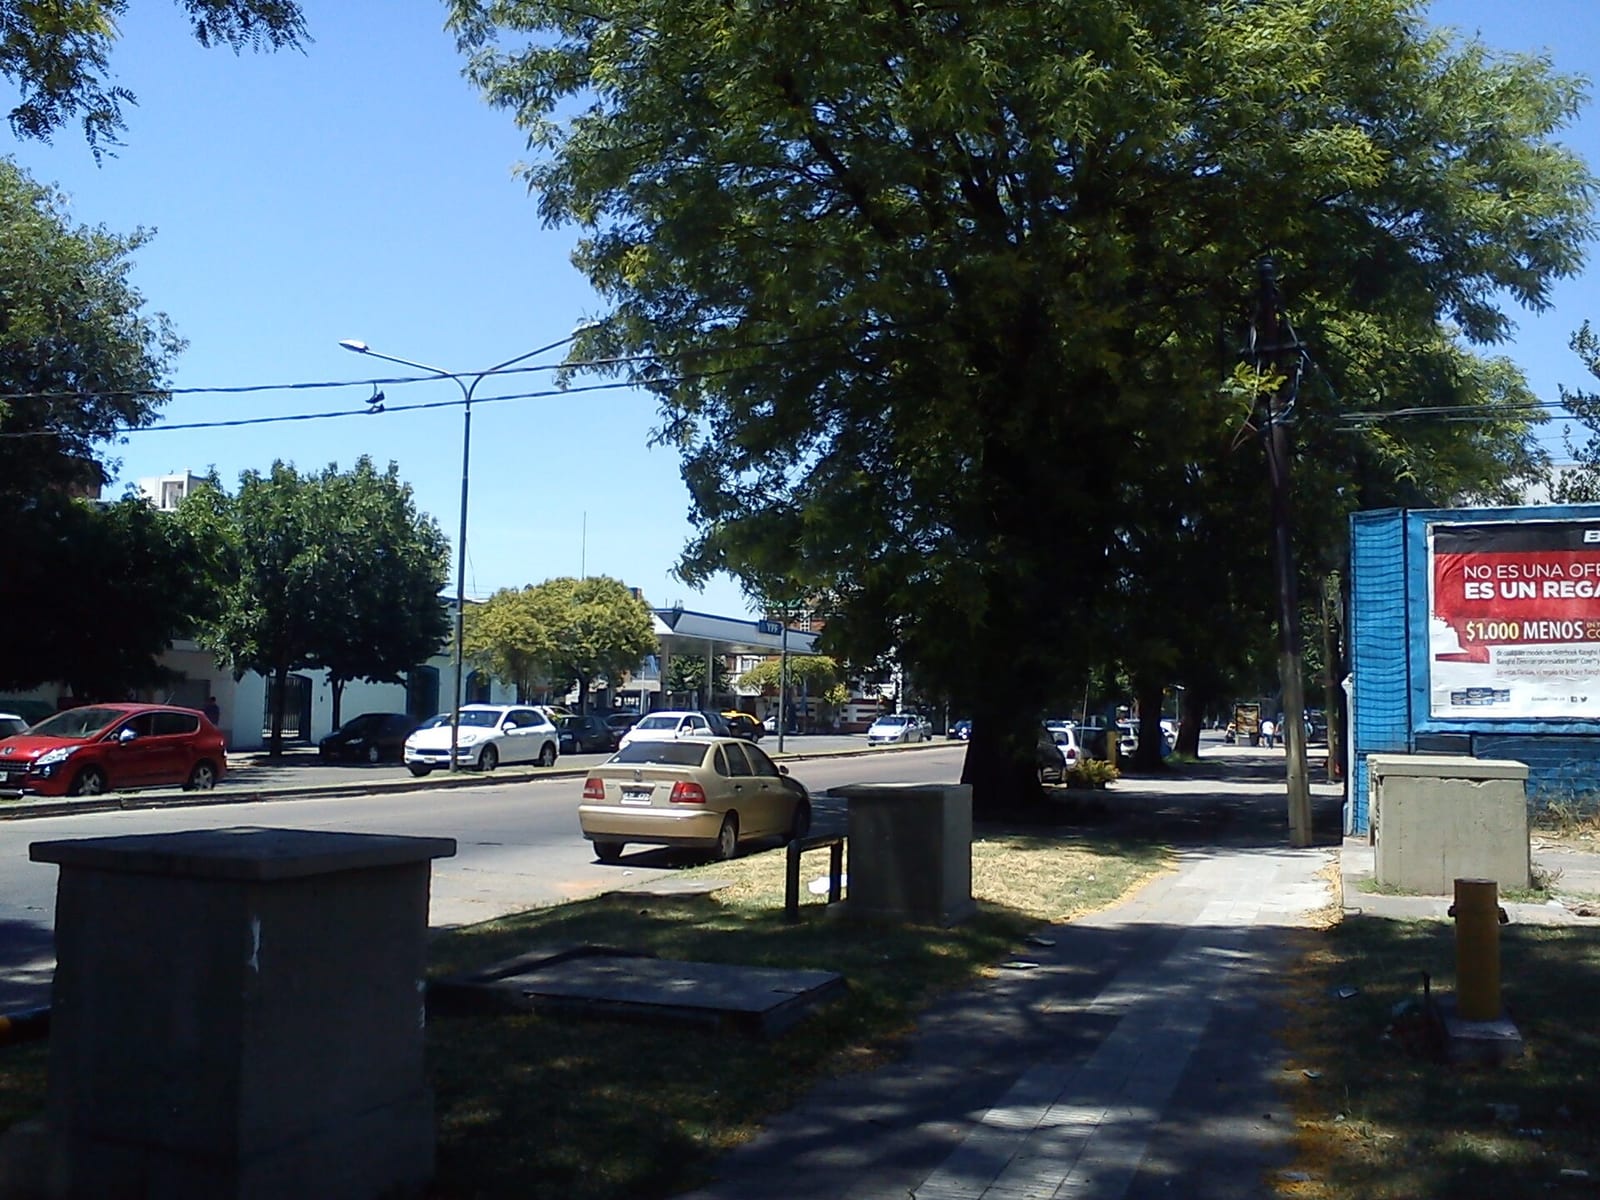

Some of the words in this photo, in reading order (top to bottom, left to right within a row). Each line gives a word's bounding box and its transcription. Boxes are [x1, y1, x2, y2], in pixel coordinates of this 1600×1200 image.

[1464, 565, 1491, 579] NO
[1497, 564, 1518, 579] ES
[1523, 563, 1564, 578] UNA
[1464, 582, 1494, 599] ES
[1500, 581, 1536, 598] UN
[1466, 621, 1519, 641] $1.000
[1523, 621, 1583, 639] MENOS
